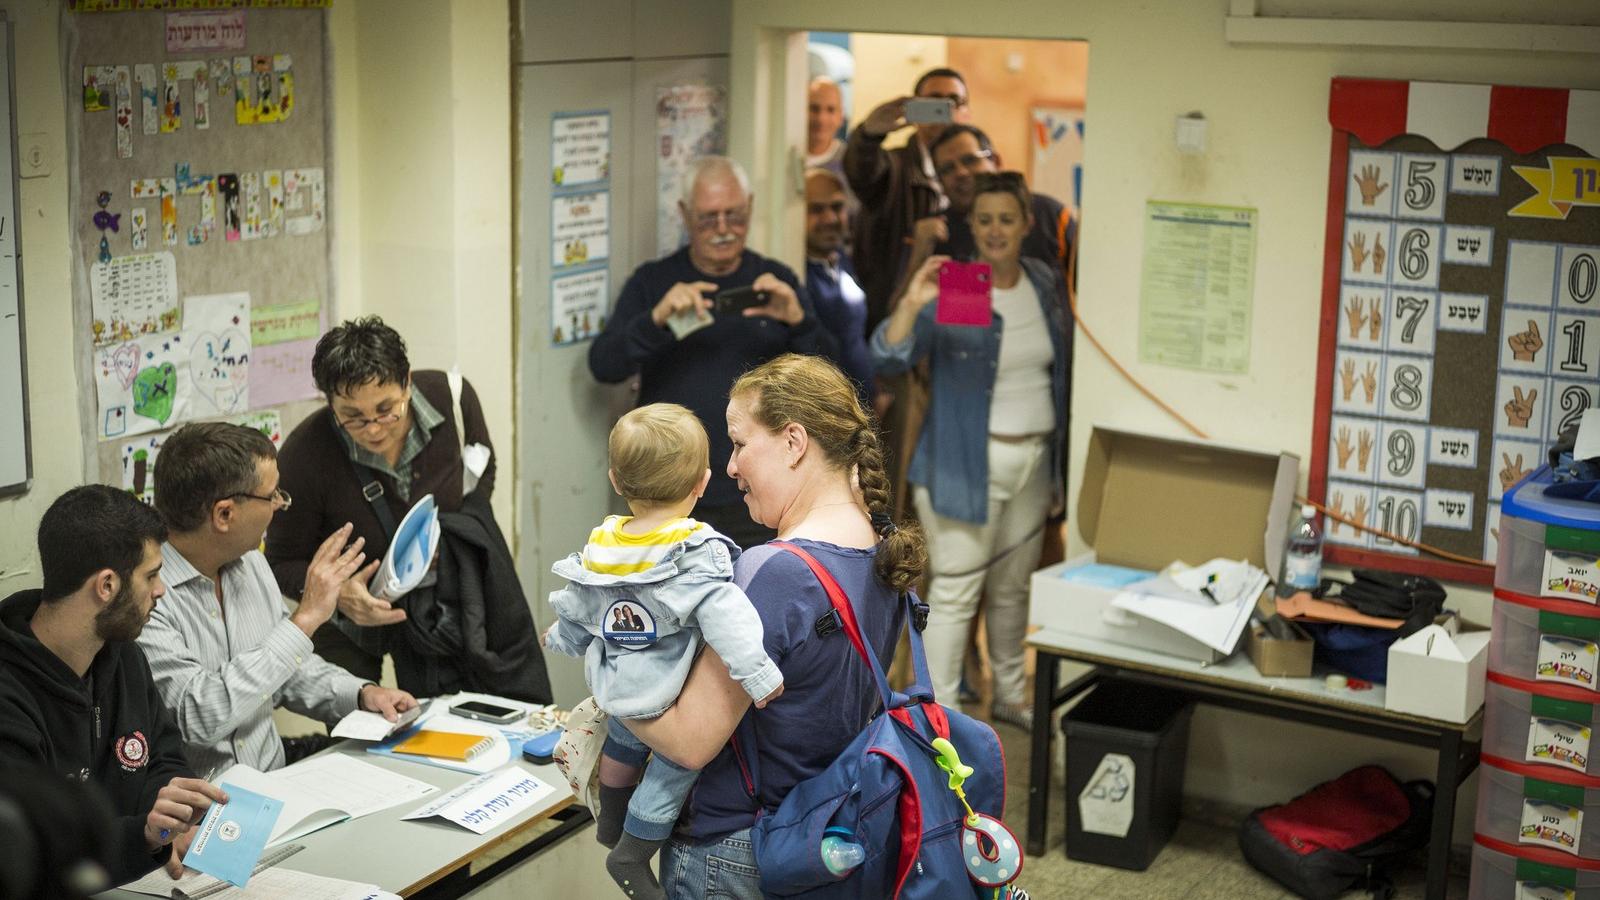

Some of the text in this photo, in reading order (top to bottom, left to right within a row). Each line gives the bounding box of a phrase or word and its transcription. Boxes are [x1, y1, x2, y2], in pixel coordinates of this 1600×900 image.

[168, 18, 244, 41] לוח מודעות
[1404, 161, 1436, 211] 5
[1572, 167, 1600, 199] ון
[1399, 228, 1430, 281] 6
[1567, 253, 1598, 304] 0
[1396, 296, 1429, 344] 7
[1560, 319, 1587, 373] 1
[1390, 364, 1422, 411] 8
[1557, 385, 1592, 437] 2
[1387, 429, 1416, 477] 9
[1375, 495, 1418, 545] 10
[1567, 566, 1588, 577] יואב
[1560, 651, 1577, 661] ליה
[1554, 732, 1574, 745] שילי
[484, 793, 514, 814] ועדת
[507, 778, 540, 799] מזכיר
[459, 807, 490, 826] קלפי
[1542, 815, 1560, 825] נטע
